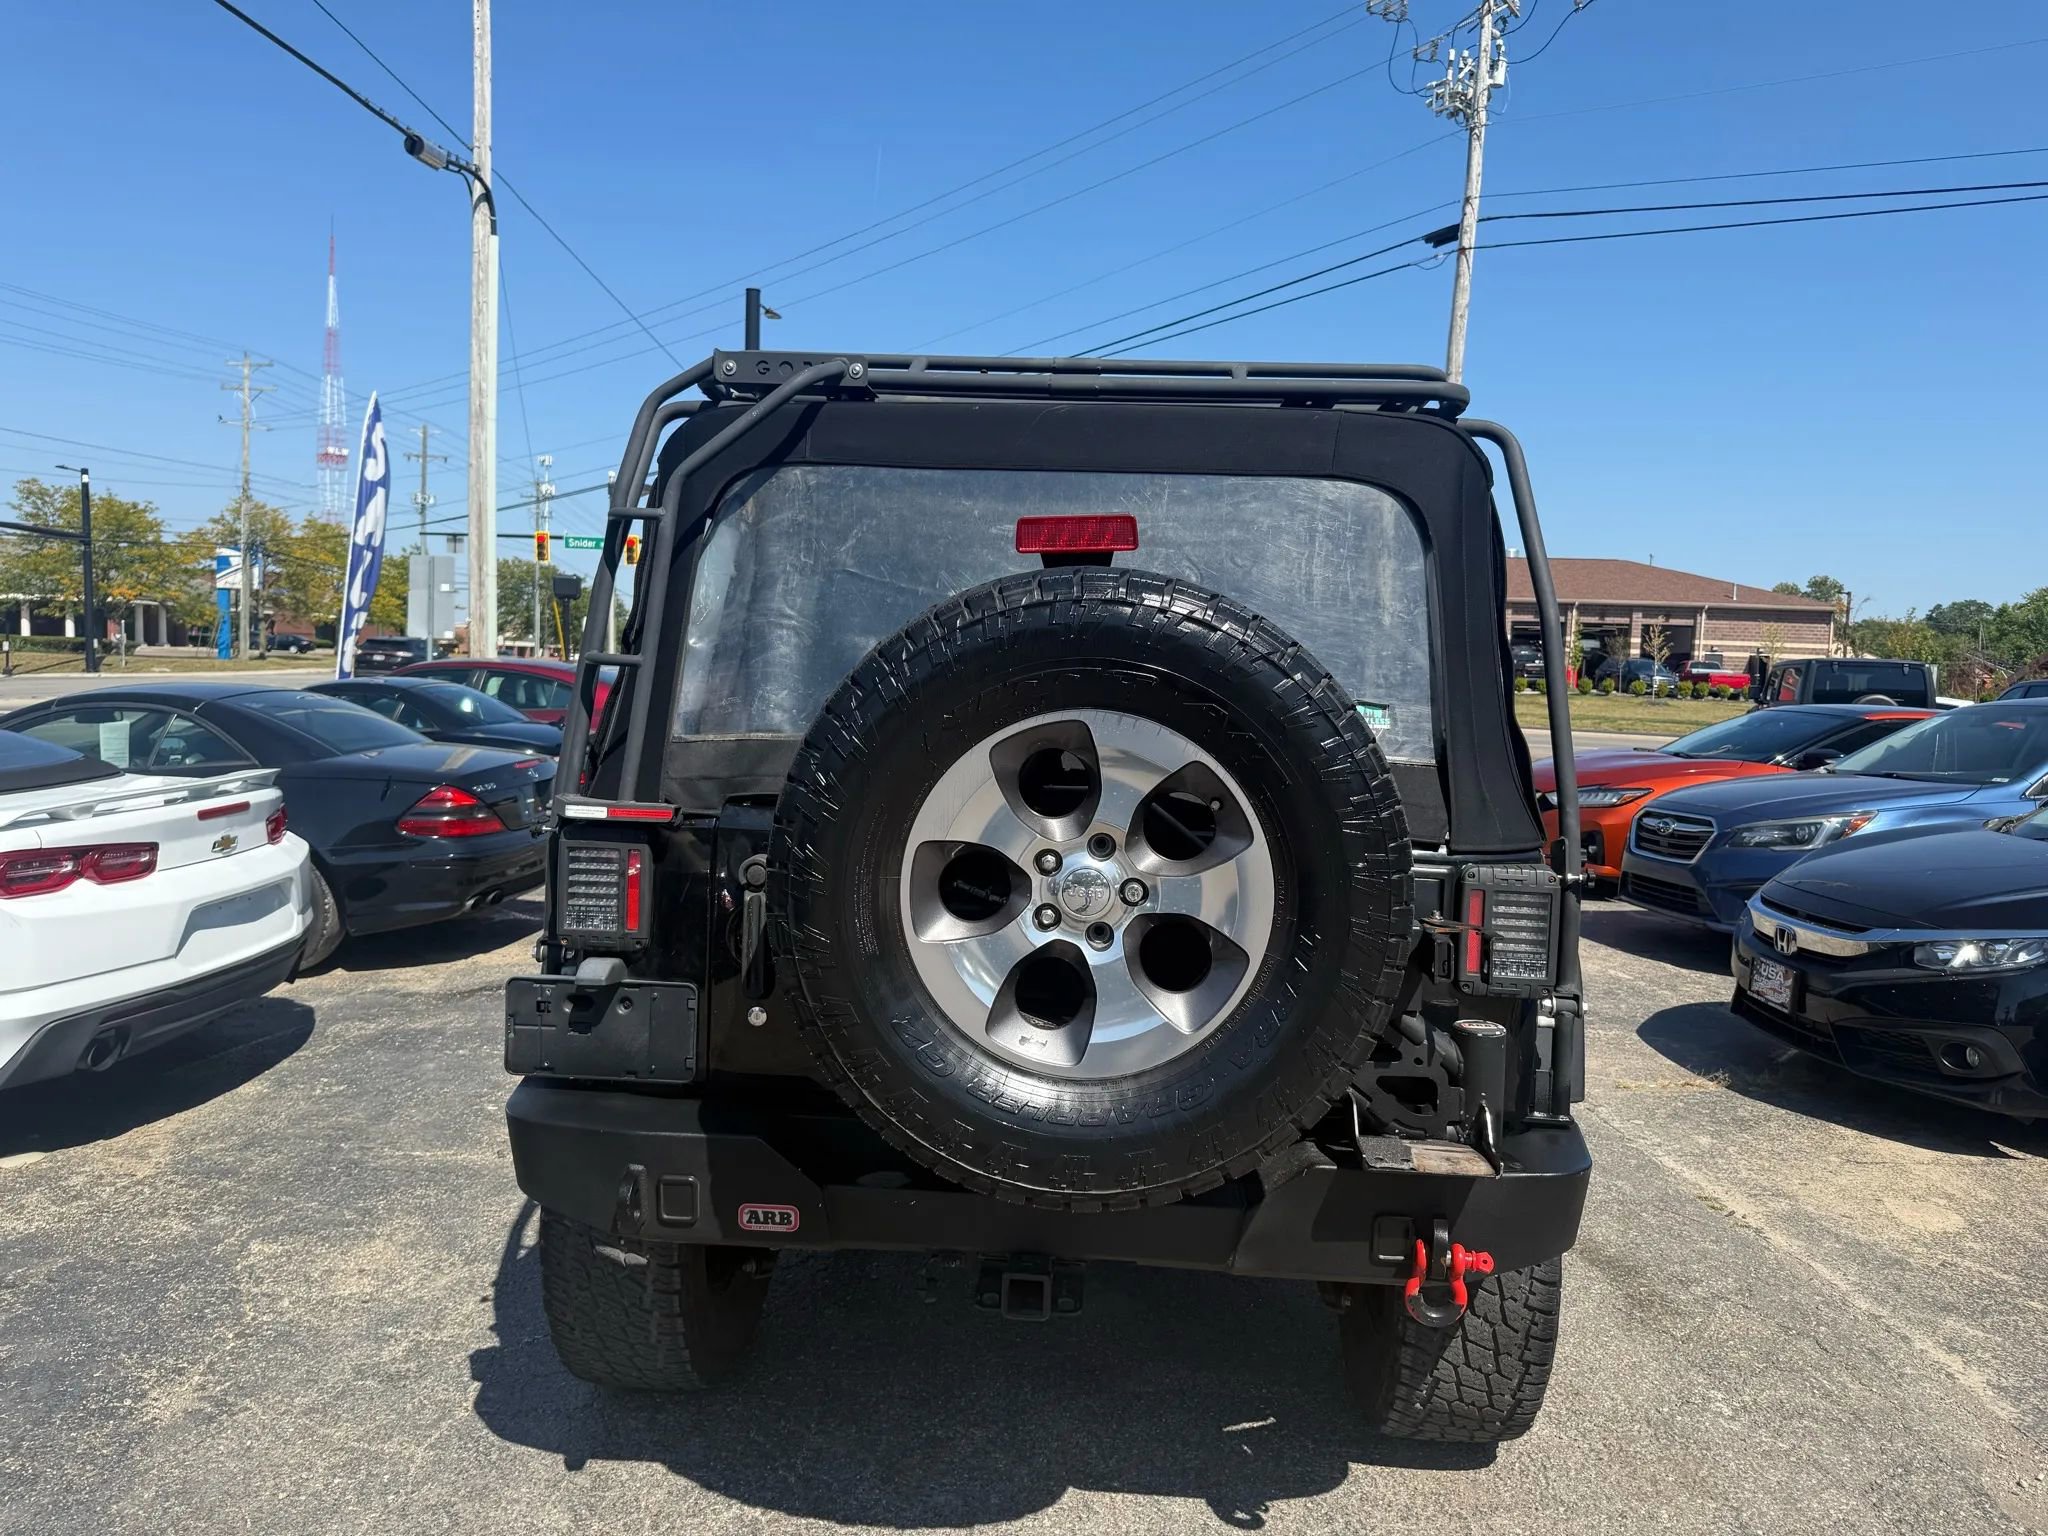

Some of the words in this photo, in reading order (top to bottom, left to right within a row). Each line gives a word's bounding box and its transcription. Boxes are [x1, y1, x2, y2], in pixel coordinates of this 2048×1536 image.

[568, 538, 596, 548] Snider
[1068, 884, 1104, 900] Jeep
[1761, 963, 1784, 983] USA
[744, 1209, 793, 1225] ARB
